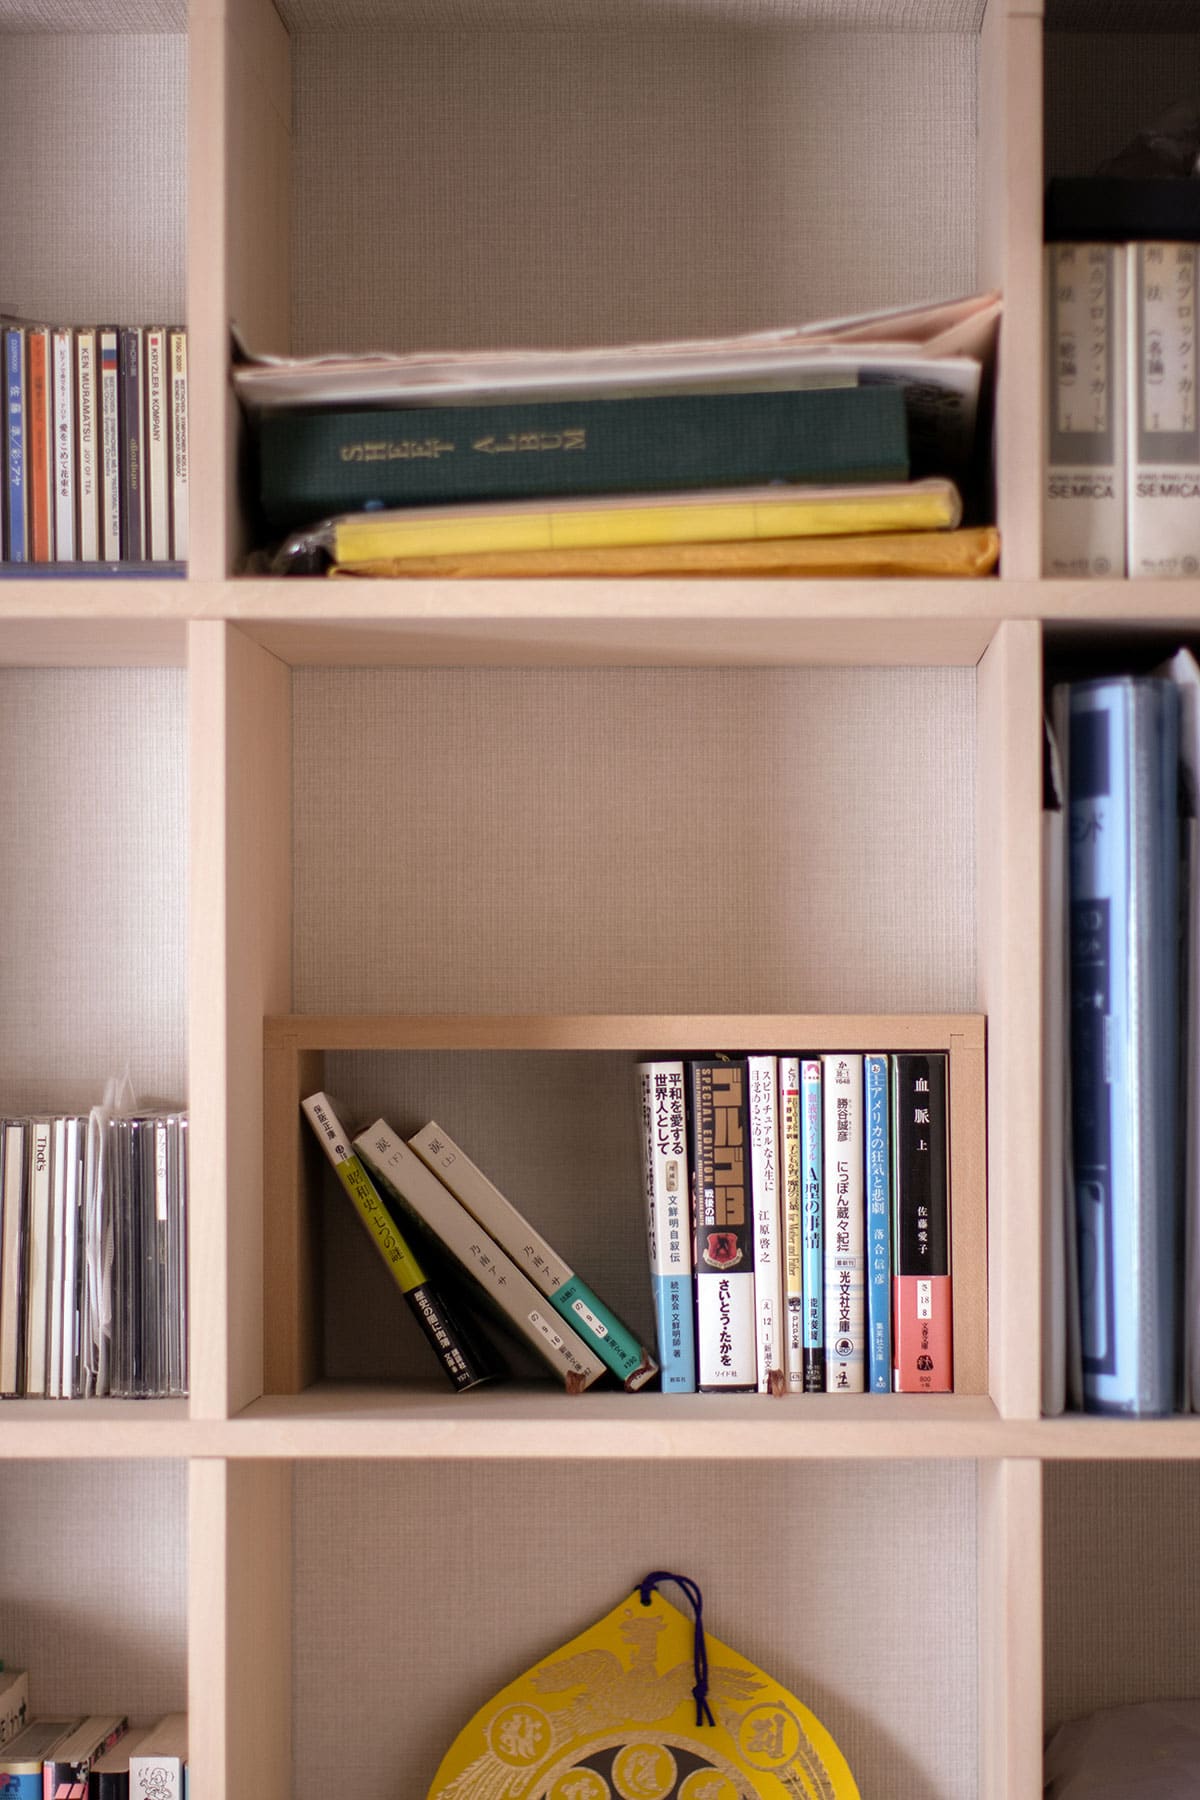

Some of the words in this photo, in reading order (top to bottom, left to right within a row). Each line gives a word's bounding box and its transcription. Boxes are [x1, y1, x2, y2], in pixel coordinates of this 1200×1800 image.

[80, 347, 90, 368] KEN
[151, 348, 160, 388] KRYZLER
[81, 371, 92, 443] MURAMATSU
[152, 398, 161, 442] KOMPANY
[340, 437, 455, 462] SHEET
[471, 428, 587, 454] ALBUM
[84, 466, 91, 477] OF
[1048, 483, 1114, 499] SEMICA
[1136, 482, 1200, 498] SEMICA
[838, 1060, 848, 1069] か
[654, 1073, 671, 1156] 世界人として
[668, 1073, 684, 1155] 平和を愛する
[702, 1068, 713, 1120] SPECIAL
[914, 1077, 931, 1125] 血脈
[762, 1070, 774, 1192] スピリチュアルな人生に
[837, 1098, 848, 1143] 勝谷誠彦
[703, 1128, 714, 1183] EDITION
[871, 1087, 885, 1215] アメリカの狂気と悲劇
[916, 1139, 928, 1151] 上
[346, 1169, 377, 1212] 昭和史
[373, 1215, 405, 1263] 七つの謎
[836, 1160, 850, 1252] にっぽん蔵々紀行
[667, 1195, 681, 1263] 文鮮明自叙伝
[758, 1210, 772, 1264] 江原啓之
[917, 1206, 929, 1255] 佐藤愛子
[469, 1243, 508, 1287] 乃南アサ
[523, 1244, 562, 1287] 乃南アサ
[873, 1228, 886, 1285] 落合信彦
[530, 1313, 539, 1322] の
[670, 1280, 680, 1311] 統一教会
[838, 1271, 851, 1333] 光文社文庫
[574, 1301, 584, 1312] の
[595, 1323, 605, 1335] 15
[718, 1279, 732, 1367] さいとう・たかを
[763, 1317, 772, 1326] 12
[791, 1315, 799, 1350] PHP文庫
[604, 1334, 629, 1362] 新潮文庫
